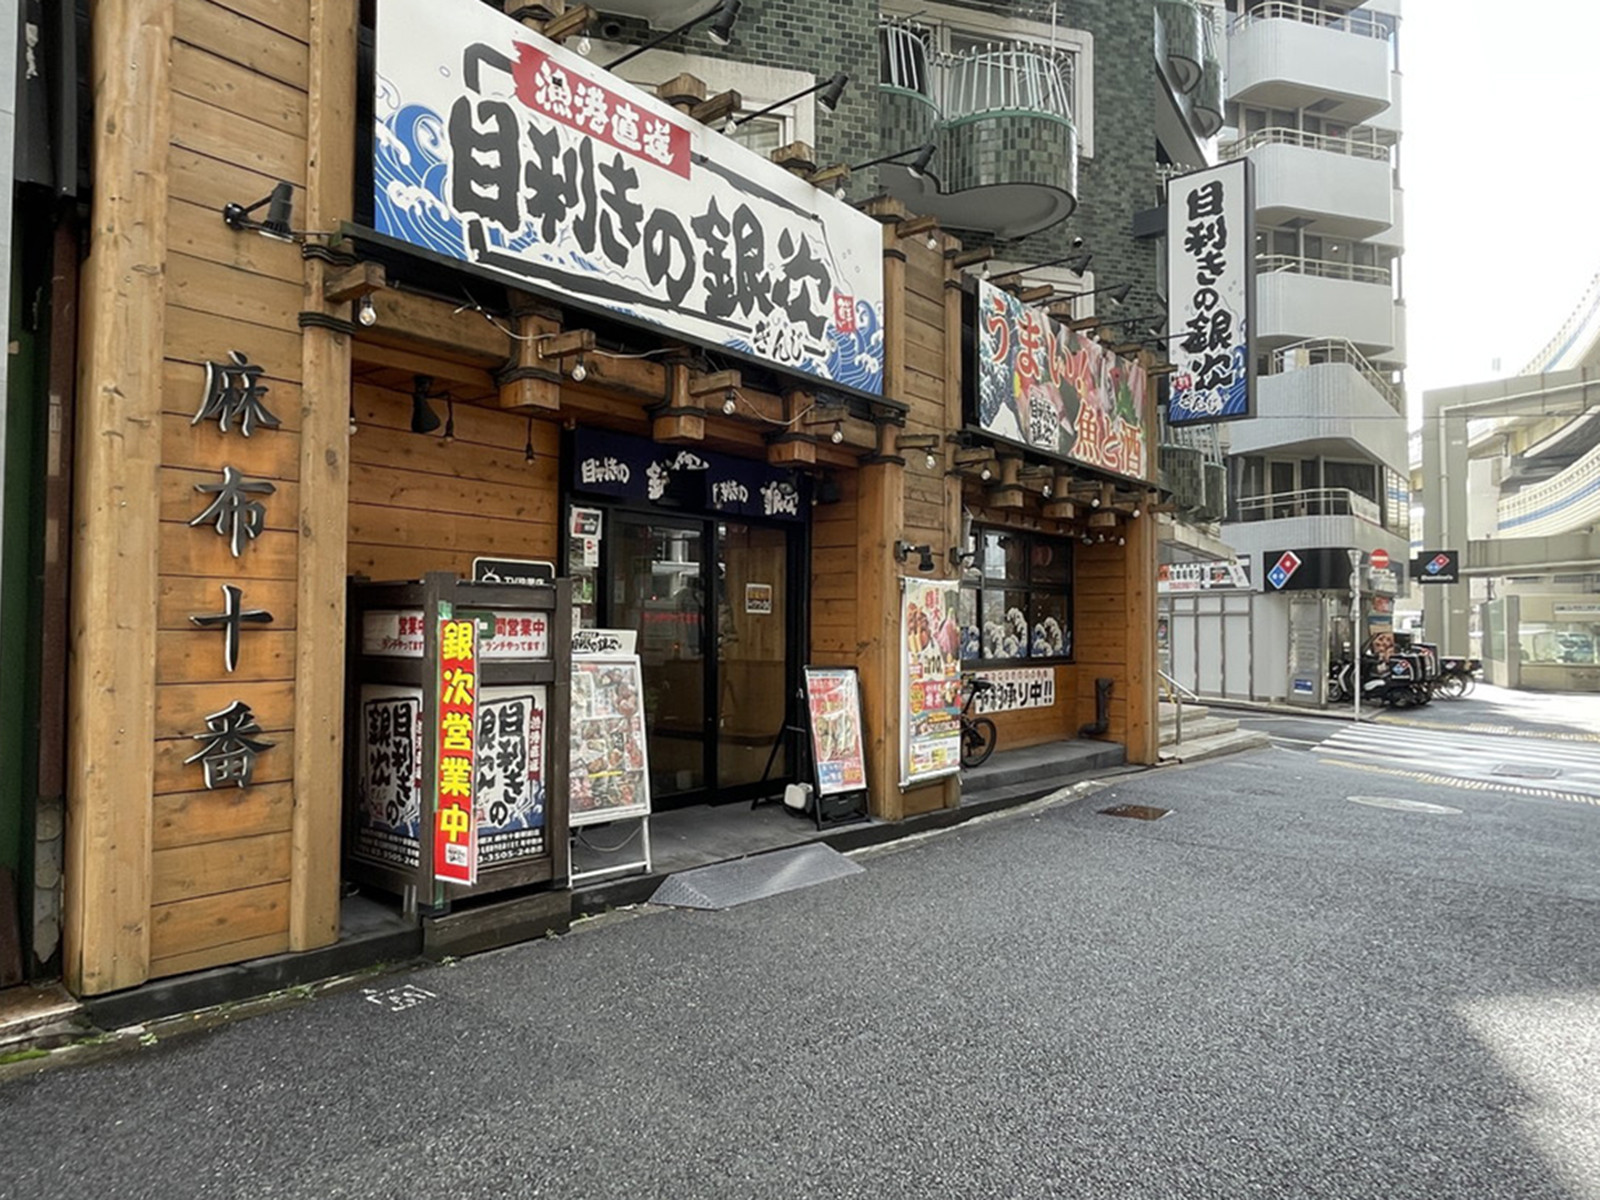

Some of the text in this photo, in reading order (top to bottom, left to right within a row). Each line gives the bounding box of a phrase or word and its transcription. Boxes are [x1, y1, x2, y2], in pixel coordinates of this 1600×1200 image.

[449, 96, 831, 342] 目利きの銀次
[534, 60, 676, 166] 漁港直送
[1180, 180, 1234, 392] 目利きの銀次
[1074, 400, 1141, 476] 魚と酒
[183, 350, 283, 790] 麻布十番
[440, 621, 474, 843] 銀次営業中
